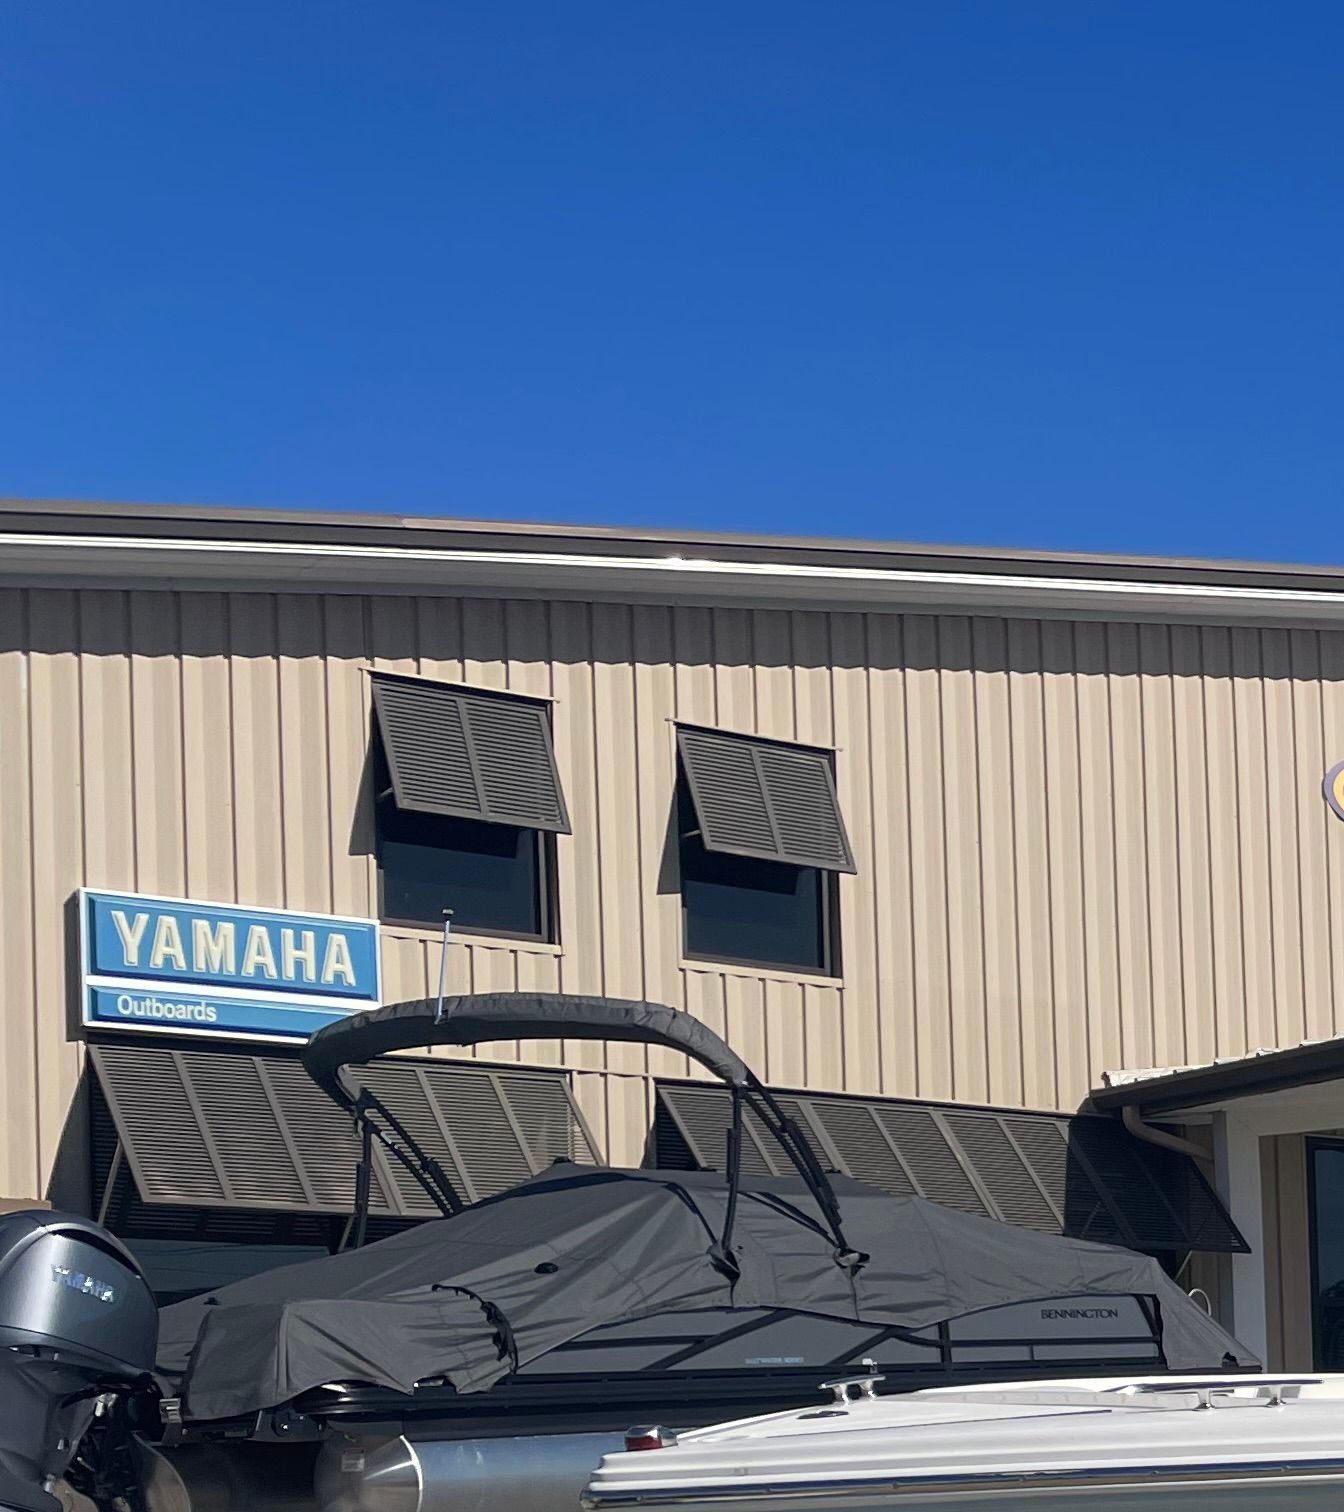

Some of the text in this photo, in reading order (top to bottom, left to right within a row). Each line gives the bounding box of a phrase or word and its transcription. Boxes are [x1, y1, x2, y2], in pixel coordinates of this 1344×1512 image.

[110, 910, 357, 987] YAMAHA
[116, 994, 217, 1023] Outboards
[1041, 1308, 1119, 1320] BENNINGTON
